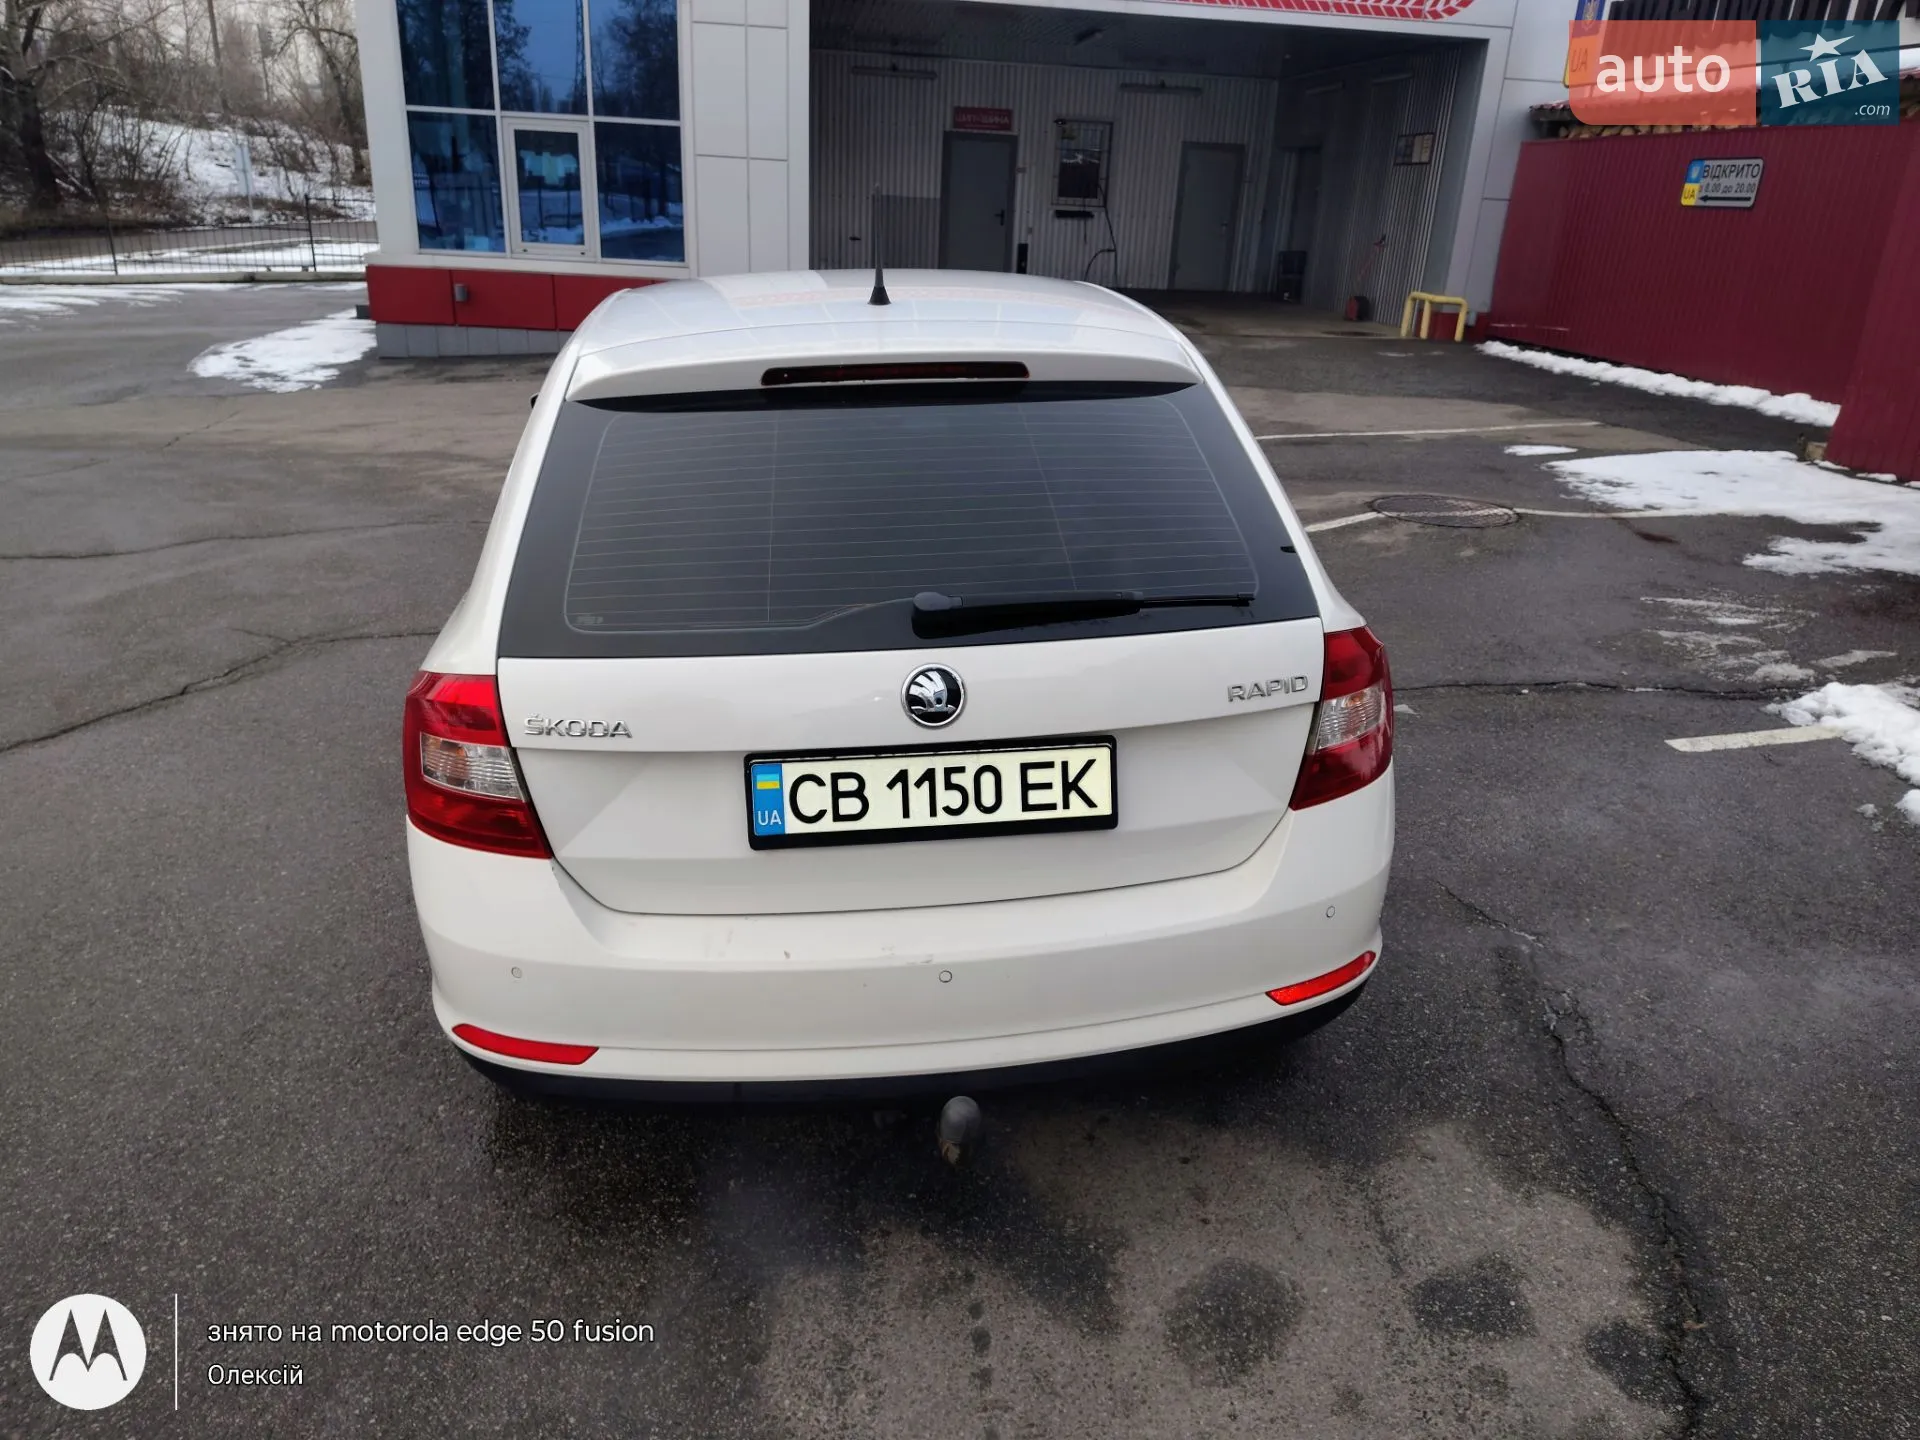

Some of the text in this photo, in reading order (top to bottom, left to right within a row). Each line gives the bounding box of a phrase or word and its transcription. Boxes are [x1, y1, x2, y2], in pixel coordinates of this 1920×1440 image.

[1702, 163, 1761, 180] ВІДКРИТО
[1683, 188, 1696, 200] UA
[1721, 185, 1733, 194] до
[1734, 182, 1757, 194] 20.00
[1227, 675, 1309, 702] RAPID
[523, 712, 633, 738] ŠKODA
[789, 758, 1098, 824] CB 1150 EK
[758, 809, 782, 826] UA
